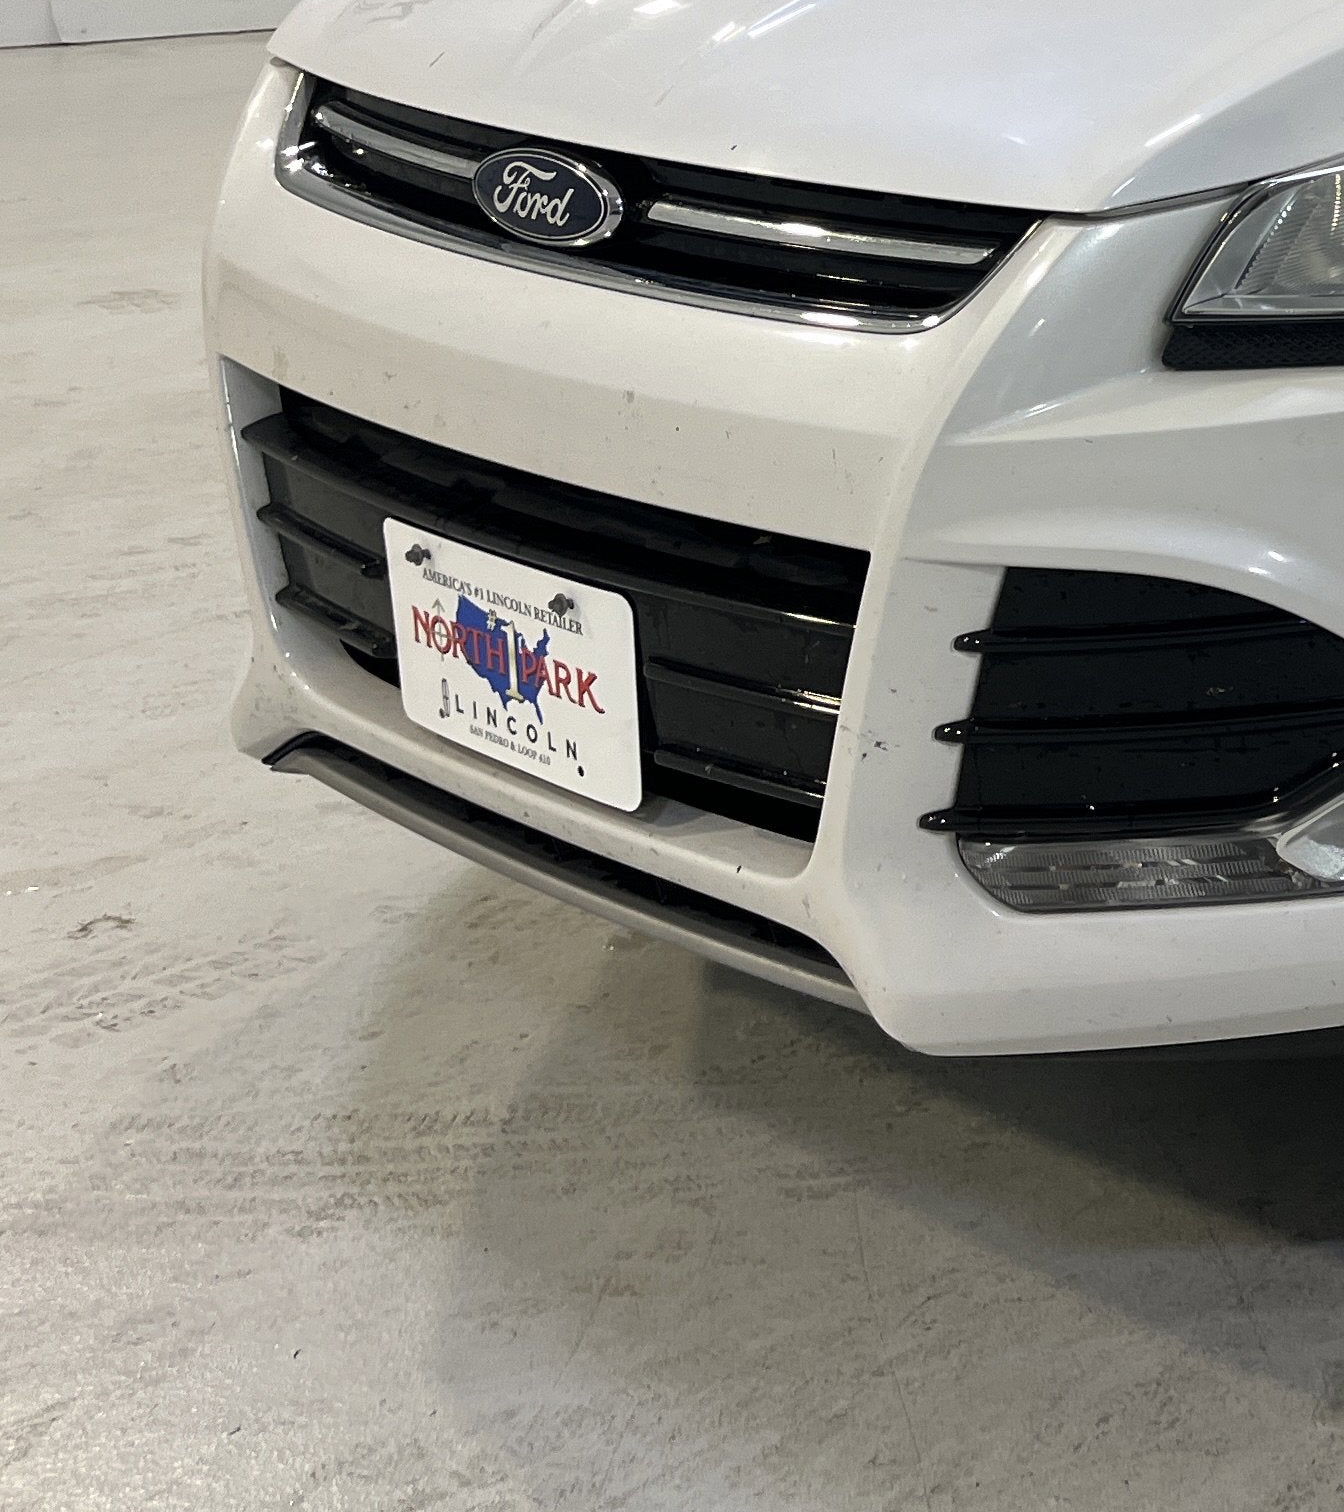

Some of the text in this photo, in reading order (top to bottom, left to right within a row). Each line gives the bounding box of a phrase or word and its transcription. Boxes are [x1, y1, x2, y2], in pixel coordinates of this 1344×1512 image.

[492, 160, 575, 227] Ford
[422, 568, 472, 597] AMERICA'S
[487, 590, 532, 618] LINCOLN
[534, 606, 583, 636] RETAILER
[411, 605, 606, 714] NORTH PARK
